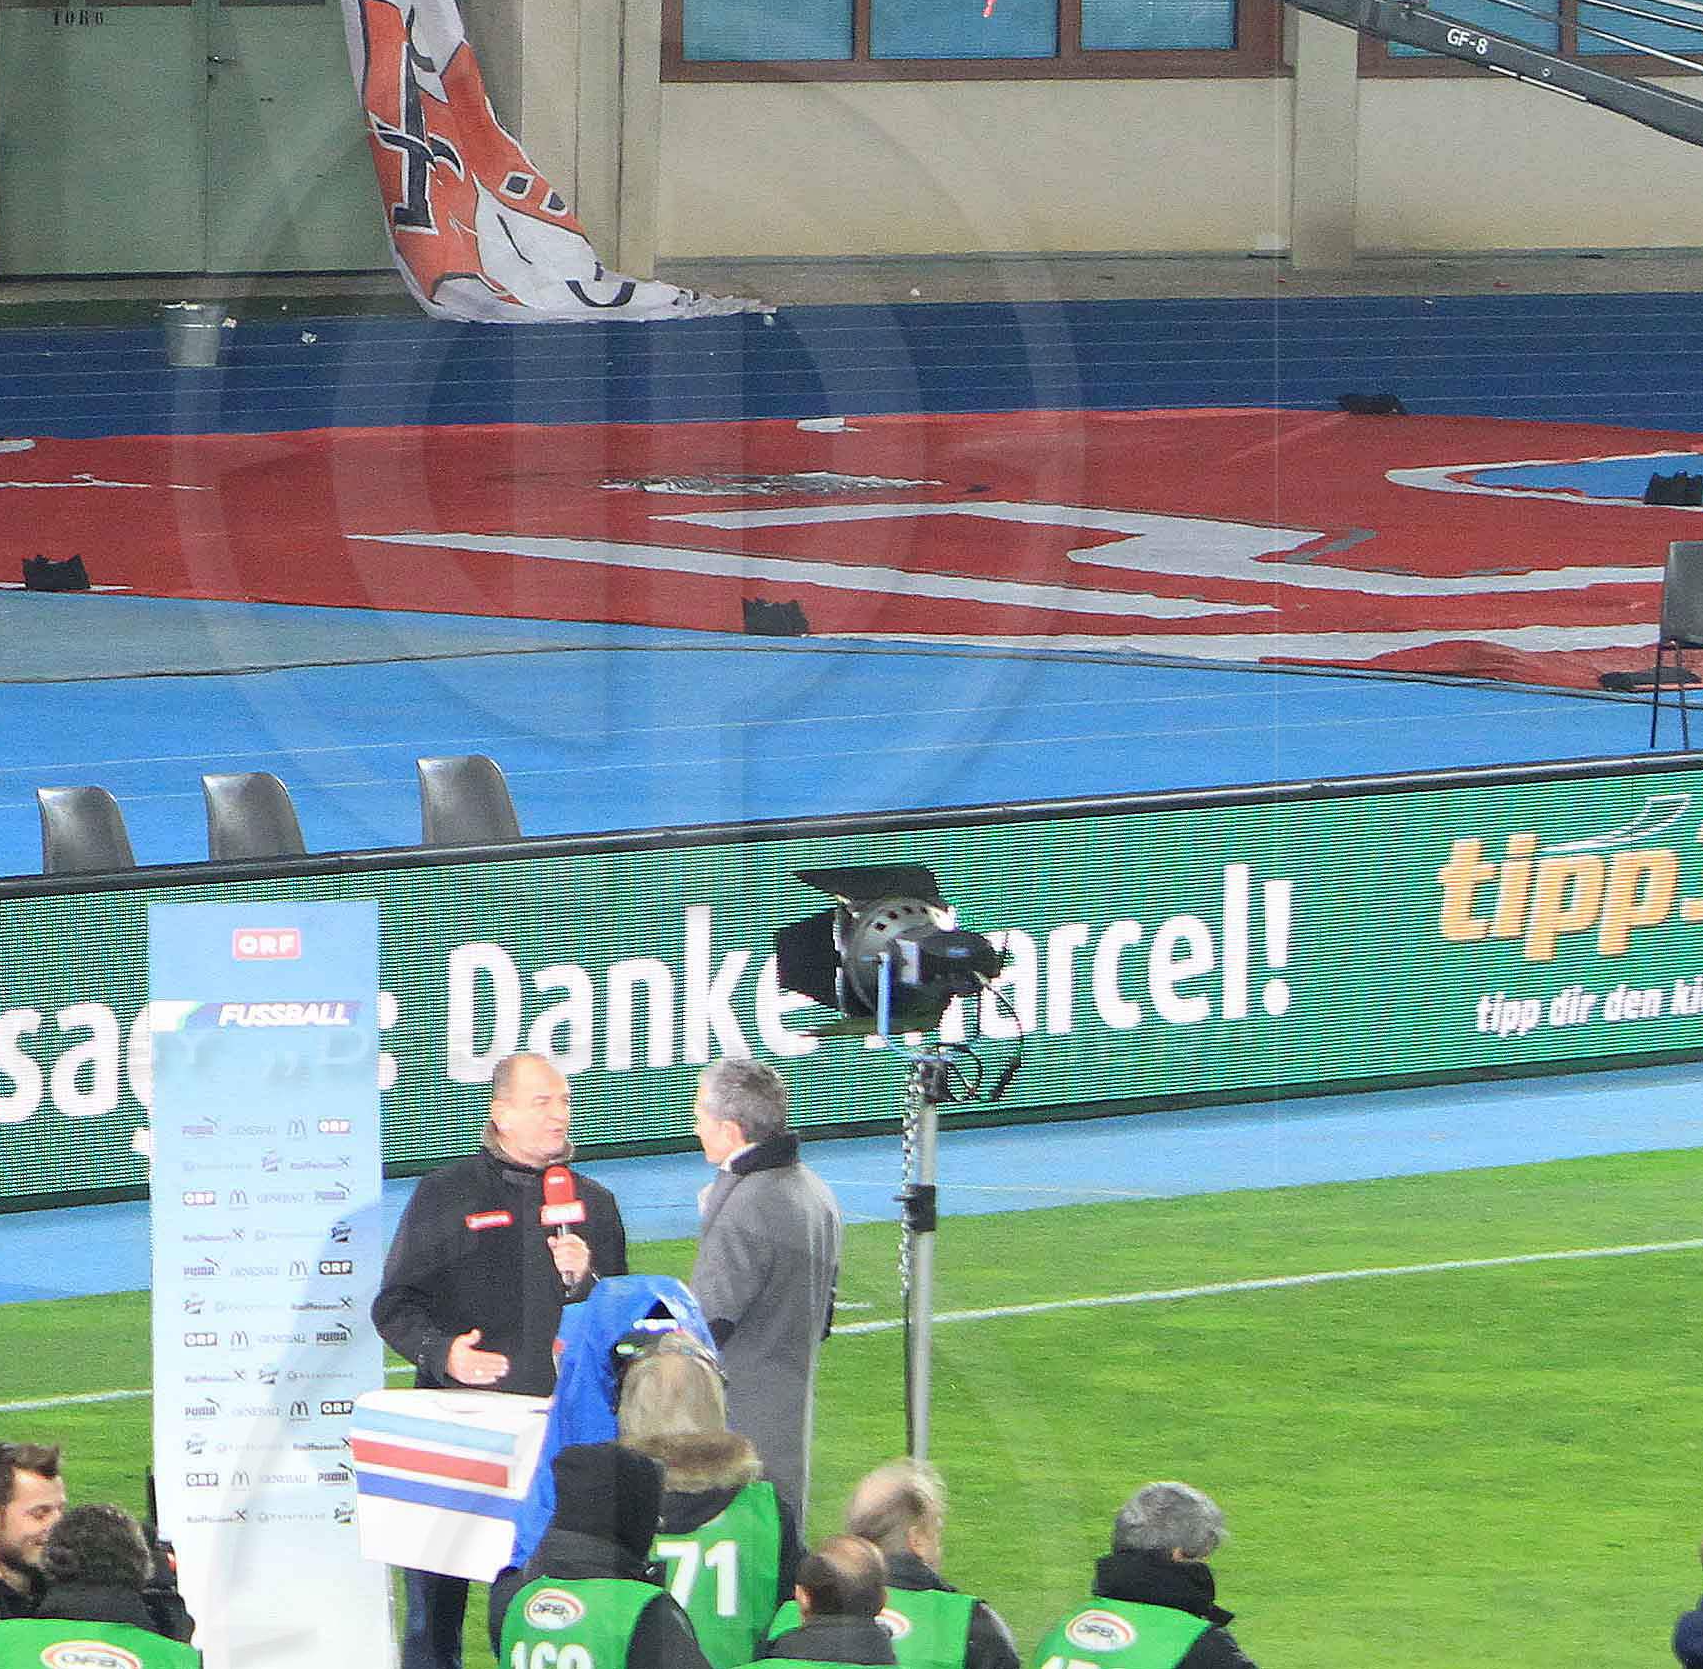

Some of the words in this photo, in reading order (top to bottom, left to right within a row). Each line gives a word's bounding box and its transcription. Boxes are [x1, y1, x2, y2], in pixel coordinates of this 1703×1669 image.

[1447, 27, 1488, 57] GF-8
[238, 935, 294, 955] ORF
[934, 862, 1294, 1042] arcel!
[218, 1002, 350, 1027] FUSSBALL
[1476, 991, 1542, 1037] tipp
[1549, 986, 1597, 1027] dir
[1603, 984, 1663, 1022] den
[320, 1262, 351, 1274] ORF
[322, 1403, 353, 1414] ORF
